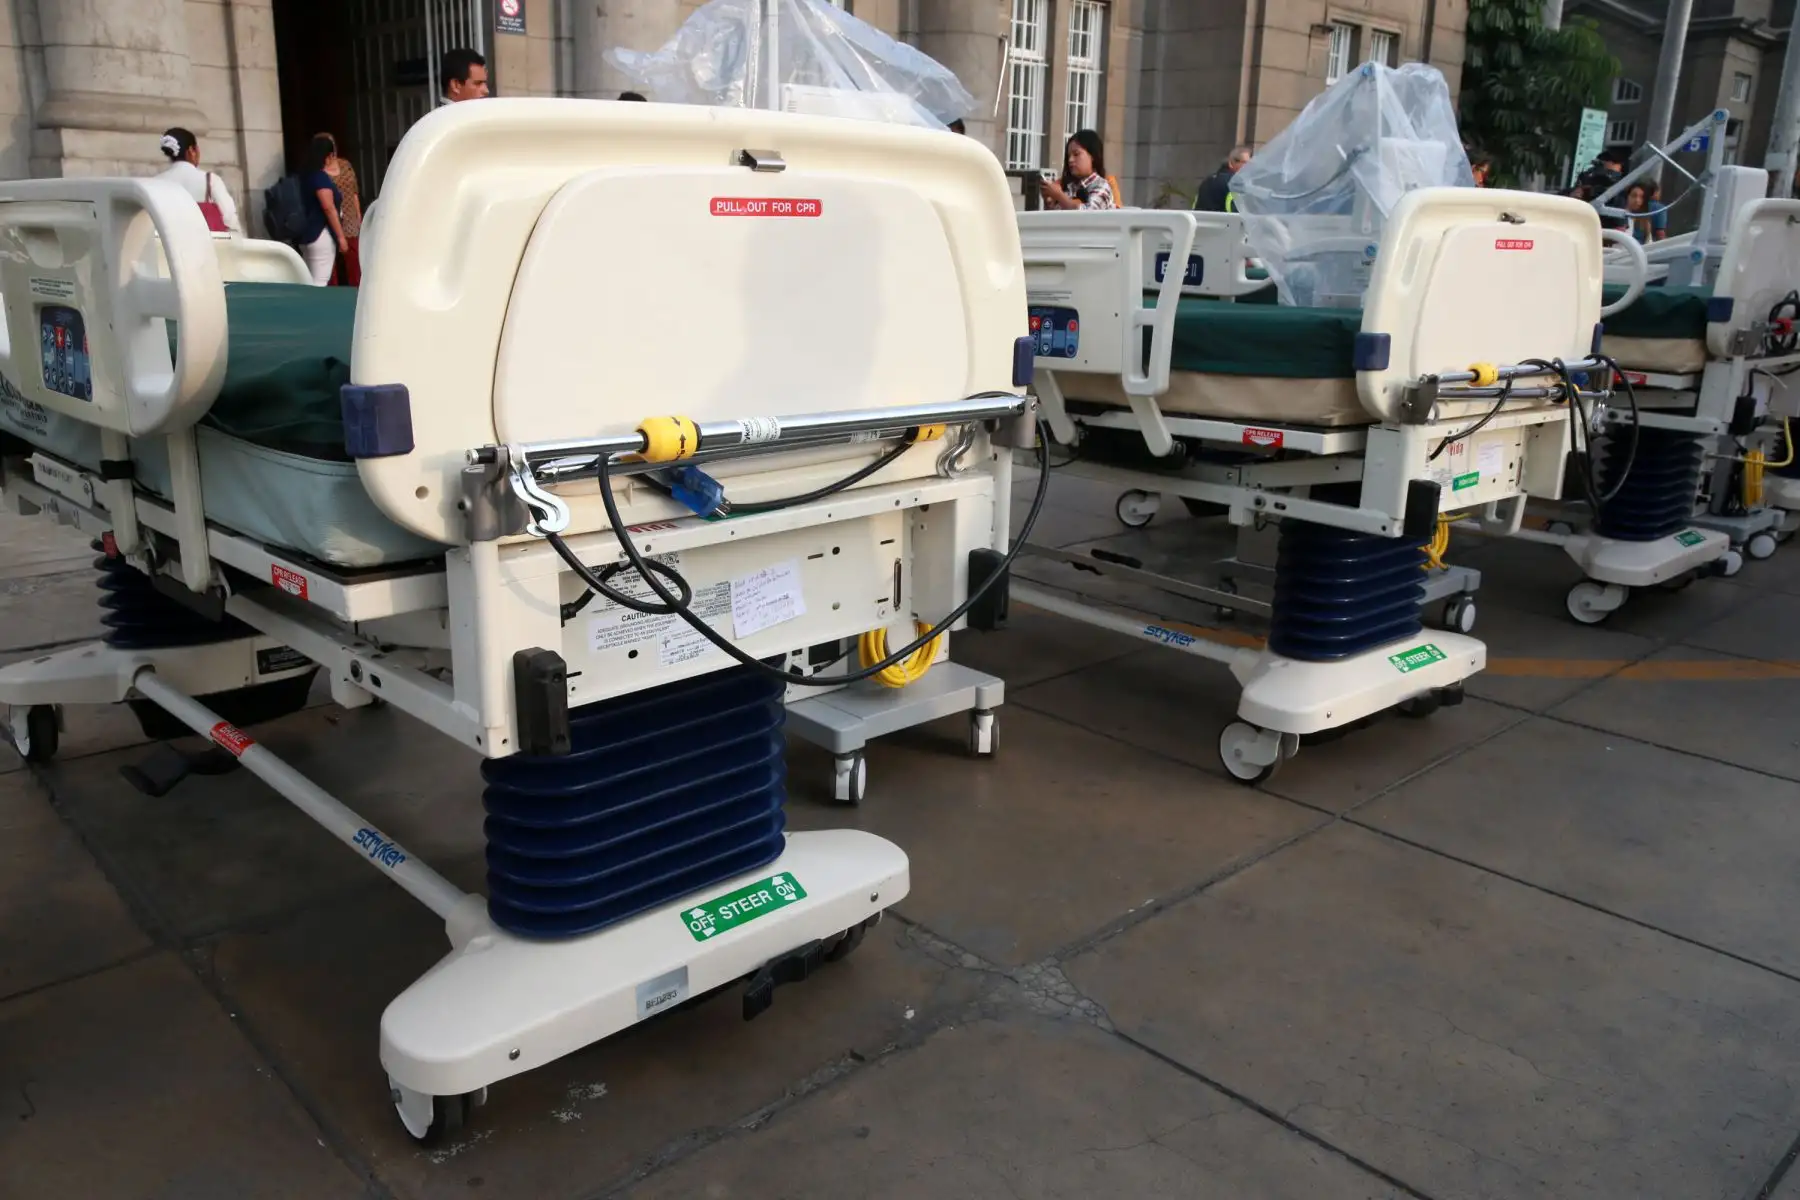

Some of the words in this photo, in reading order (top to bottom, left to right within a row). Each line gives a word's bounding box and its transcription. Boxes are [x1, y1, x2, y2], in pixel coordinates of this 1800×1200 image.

[716, 201, 742, 212] PULL
[747, 201, 767, 212] OUT
[772, 202, 792, 213] FOR
[796, 202, 816, 213] CPR
[1143, 625, 1197, 647] stryker
[352, 828, 406, 869] stryker
[690, 913, 716, 932] OFF
[718, 889, 774, 920] STEER
[775, 882, 797, 896] ON
